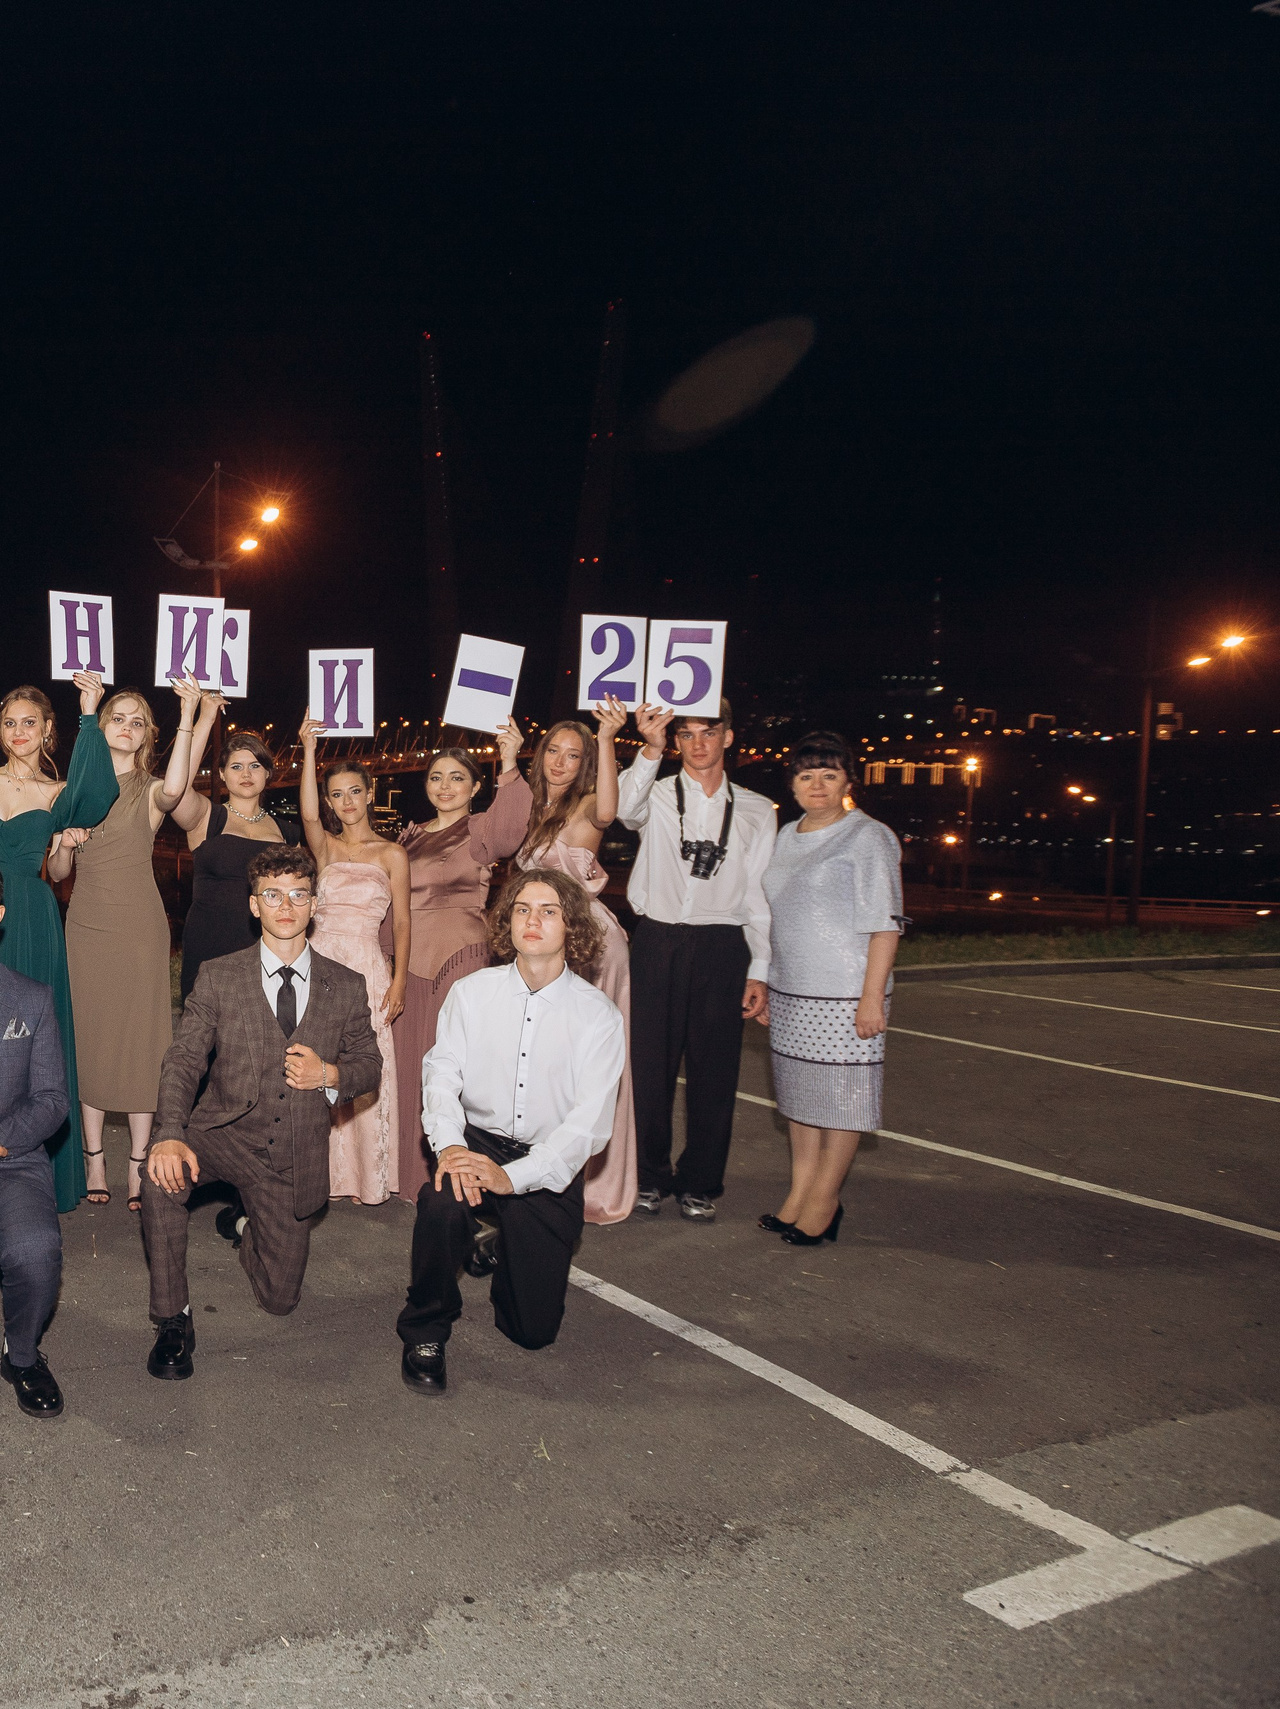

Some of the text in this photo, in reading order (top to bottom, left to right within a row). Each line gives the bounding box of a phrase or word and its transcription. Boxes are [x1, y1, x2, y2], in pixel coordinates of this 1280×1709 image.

[59, 599, 106, 674] Н
[165, 605, 214, 682] И
[318, 659, 364, 729] И
